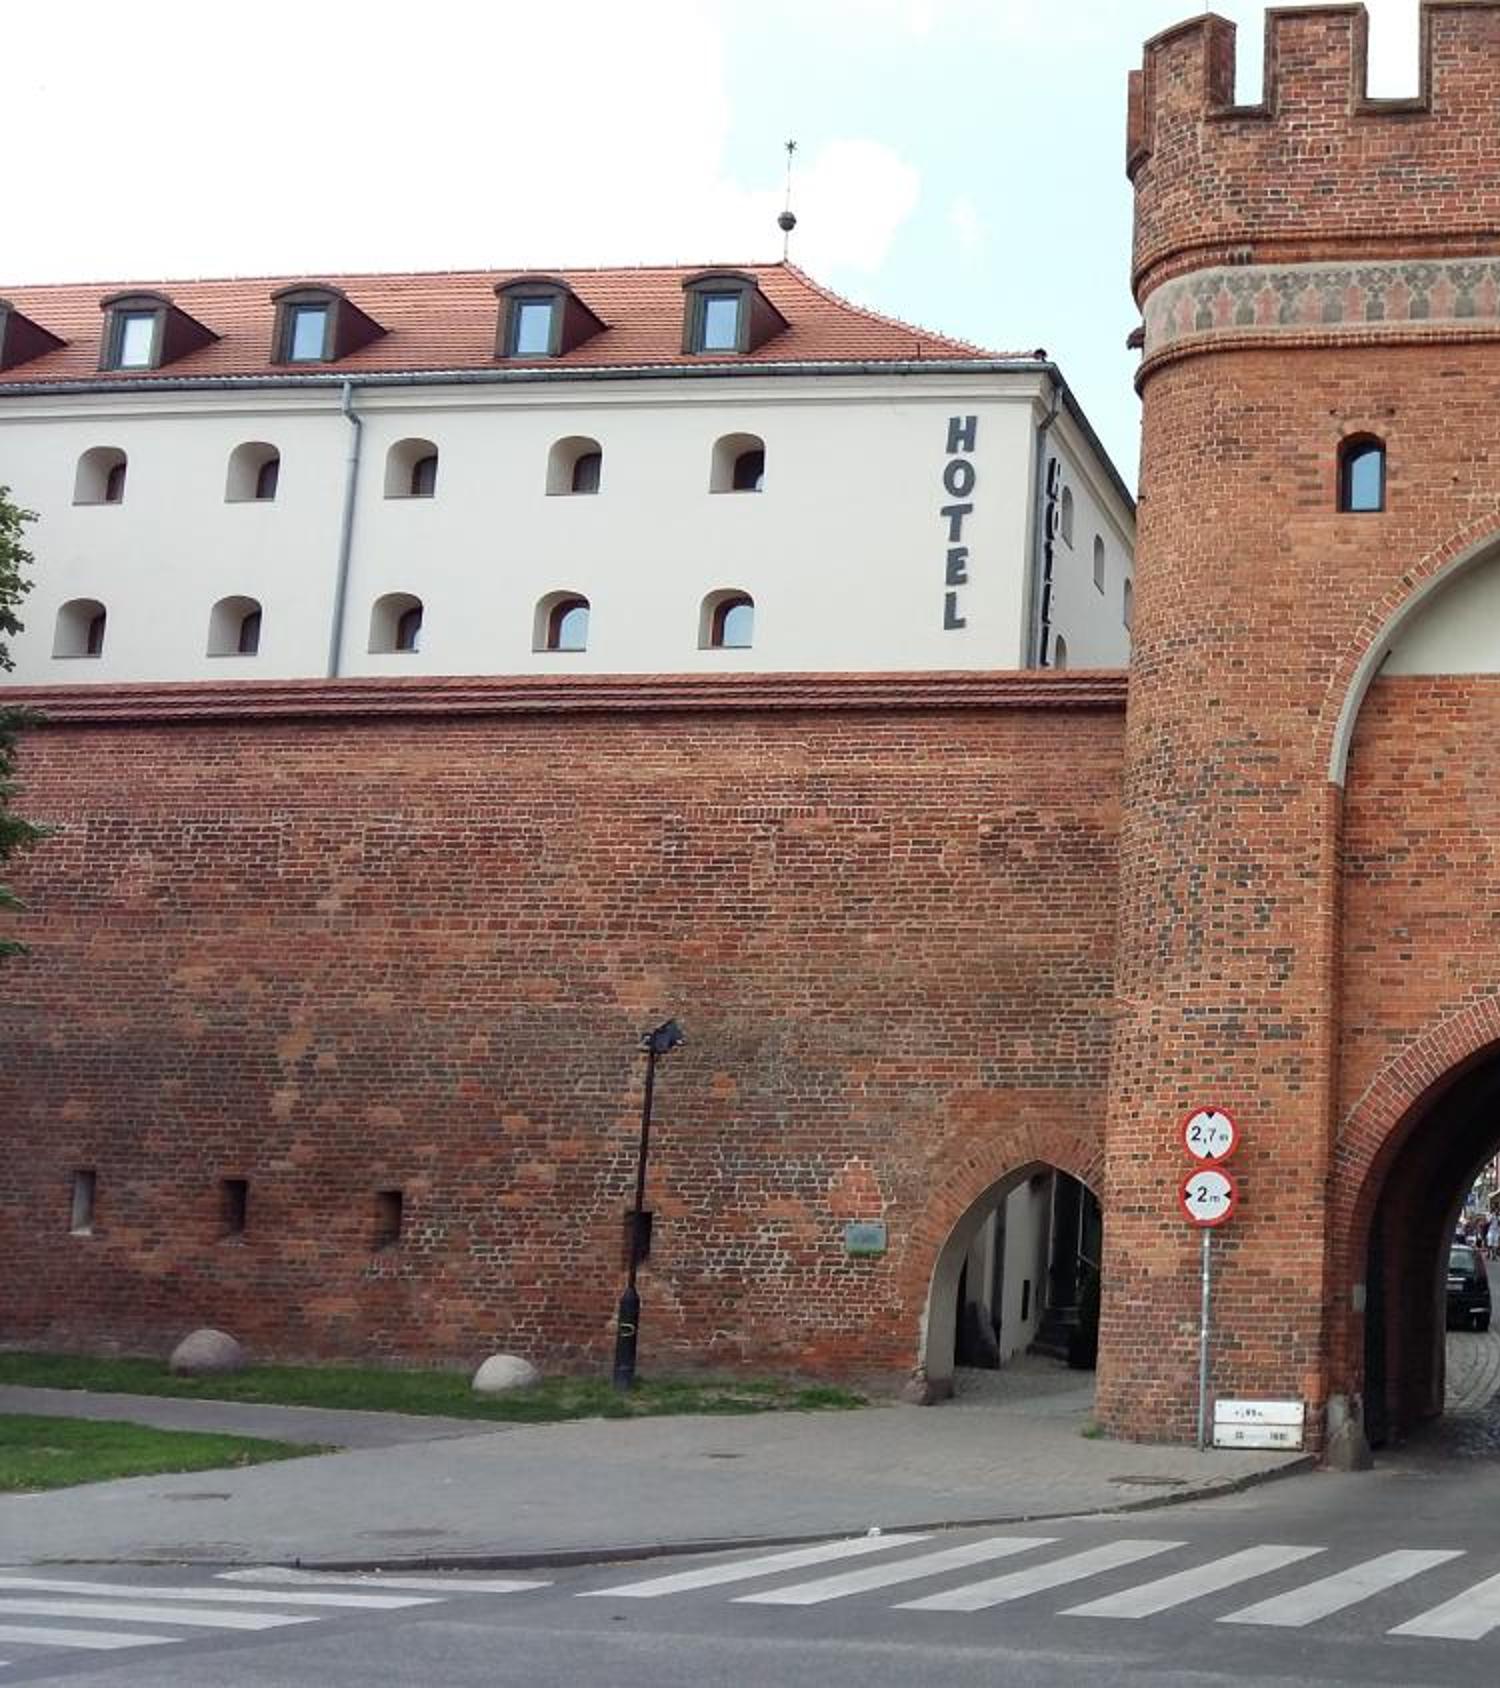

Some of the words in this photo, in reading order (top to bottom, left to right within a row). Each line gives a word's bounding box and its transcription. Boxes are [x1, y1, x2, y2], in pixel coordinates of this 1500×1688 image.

[940, 415, 977, 630] HOTEL
[1191, 1126, 1216, 1144] 2,7
[1197, 1186, 1207, 1203] 2
[1209, 1195, 1220, 1203] m
